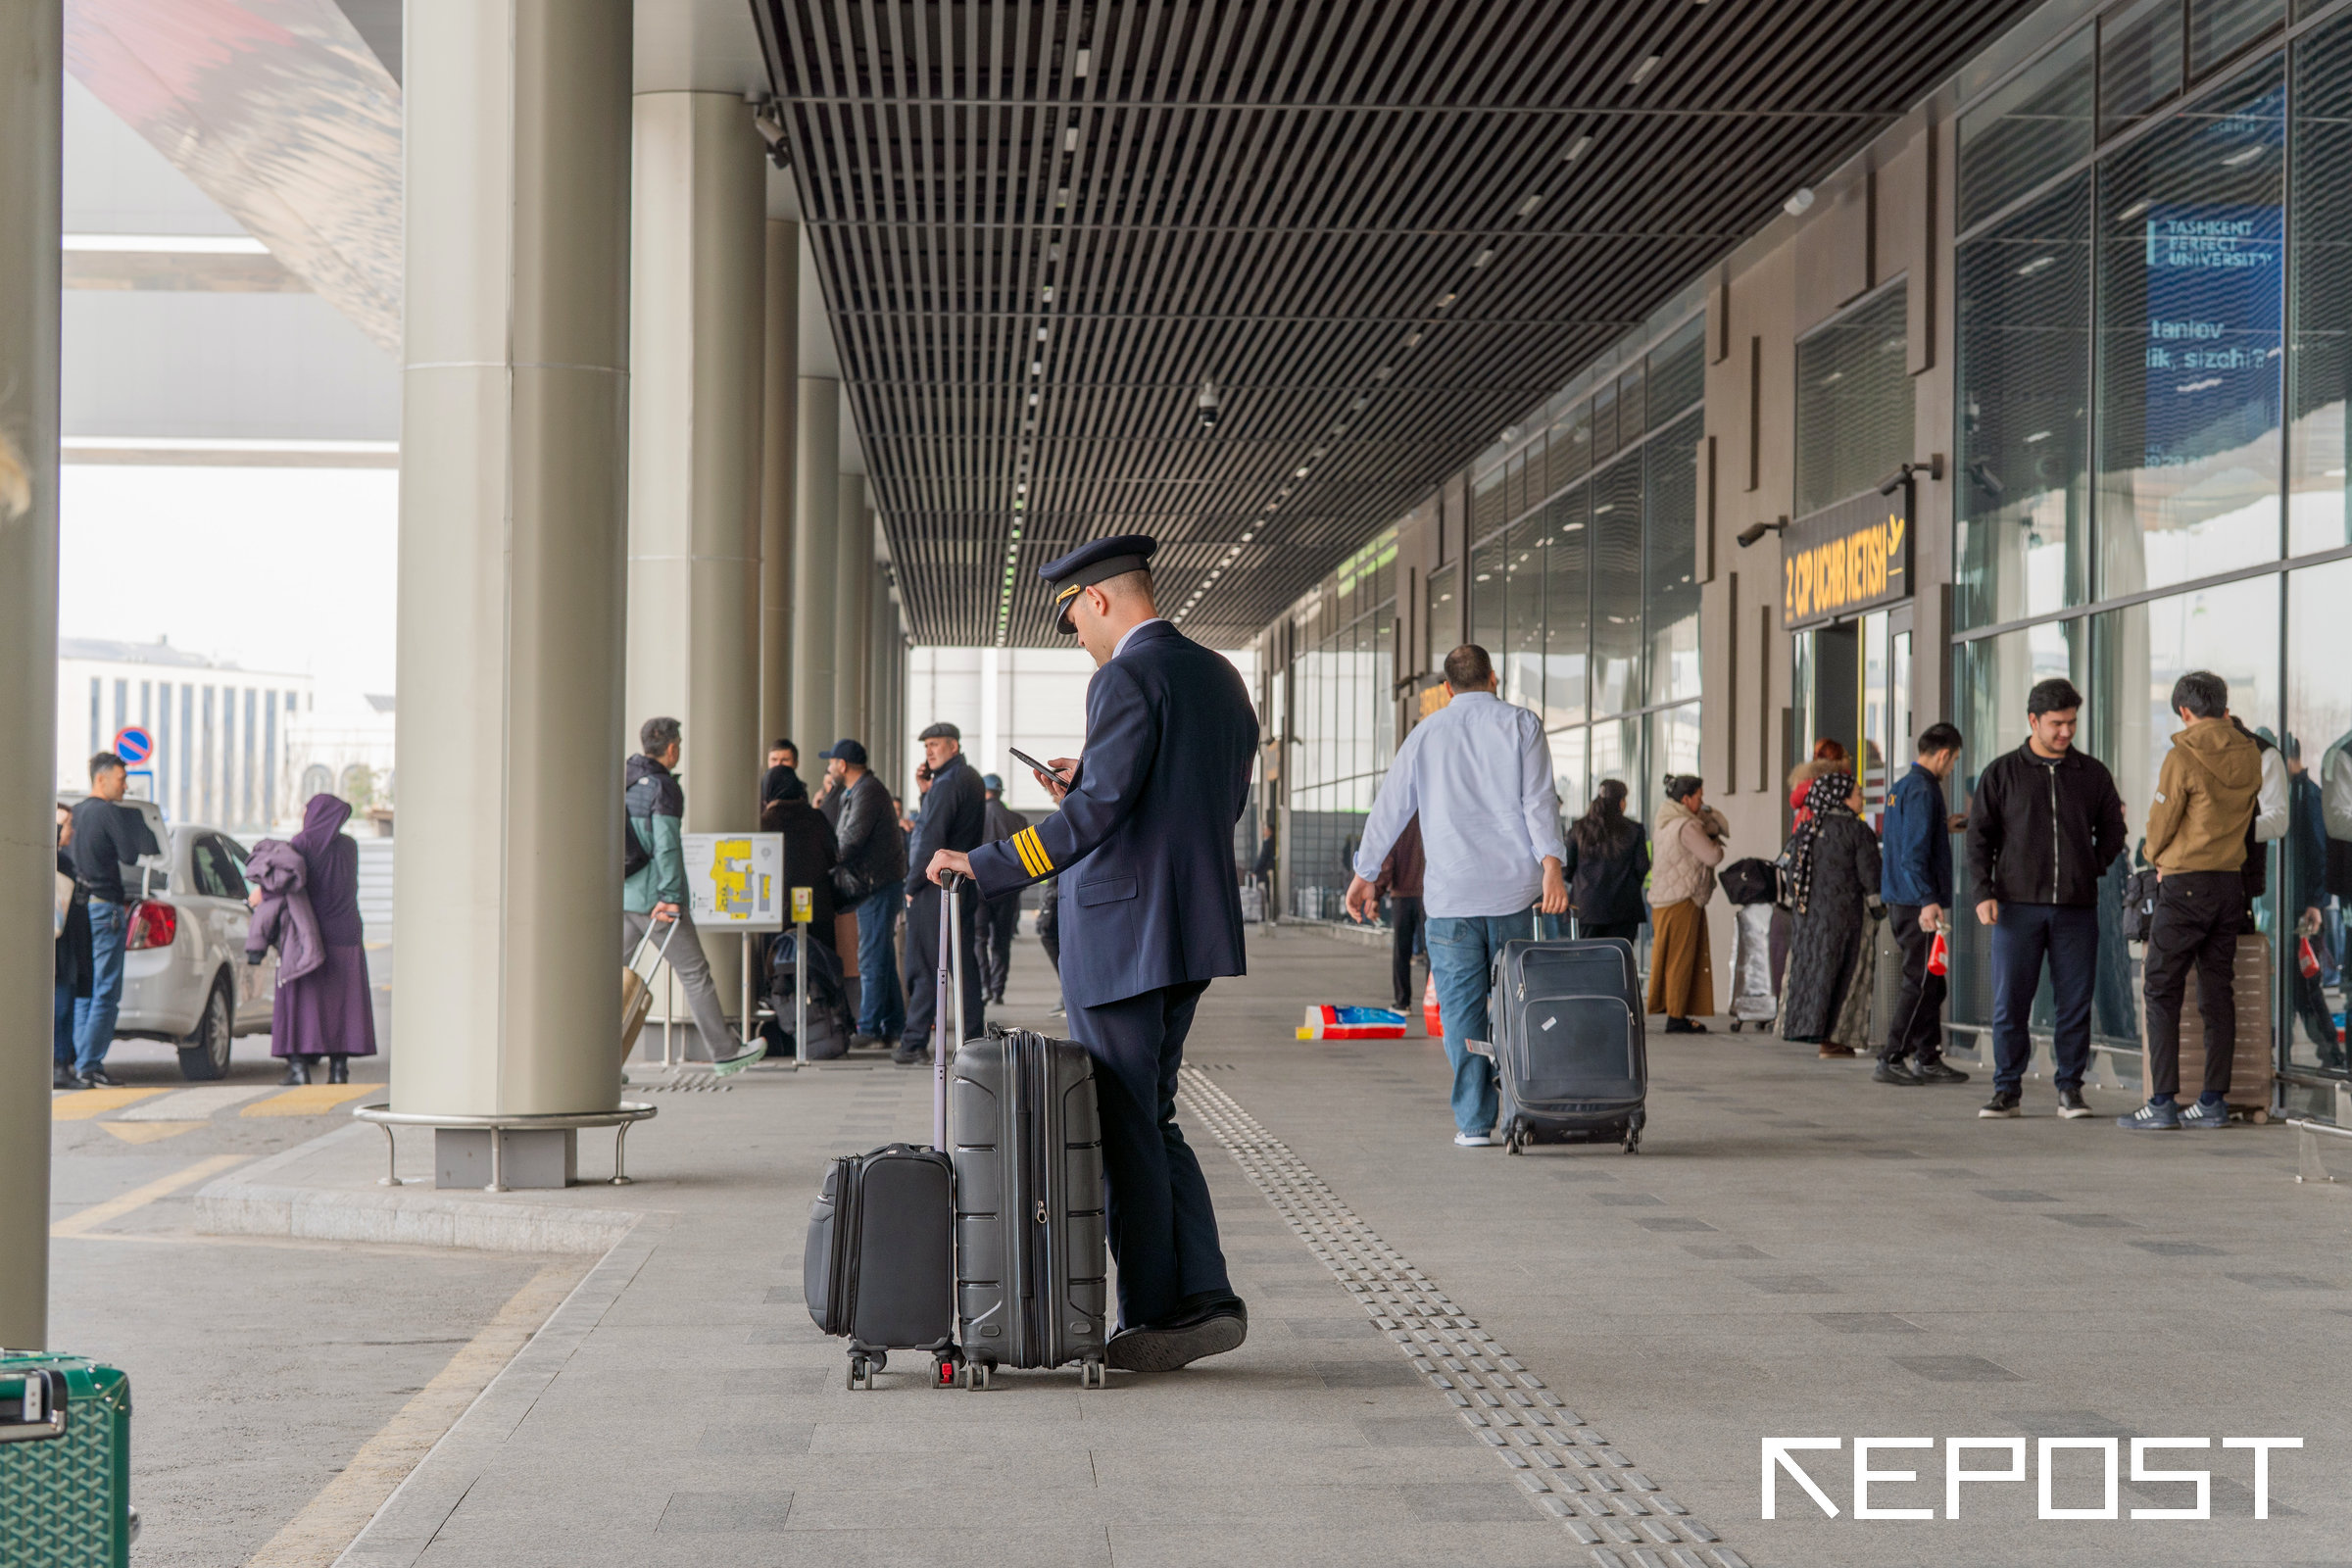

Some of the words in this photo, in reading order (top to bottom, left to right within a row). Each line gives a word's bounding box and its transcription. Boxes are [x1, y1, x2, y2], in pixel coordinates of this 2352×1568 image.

[2168, 220, 2253, 236] TASHKENT
[2169, 251, 2273, 267] UNIVERSITY
[1786, 557, 1794, 609] 2
